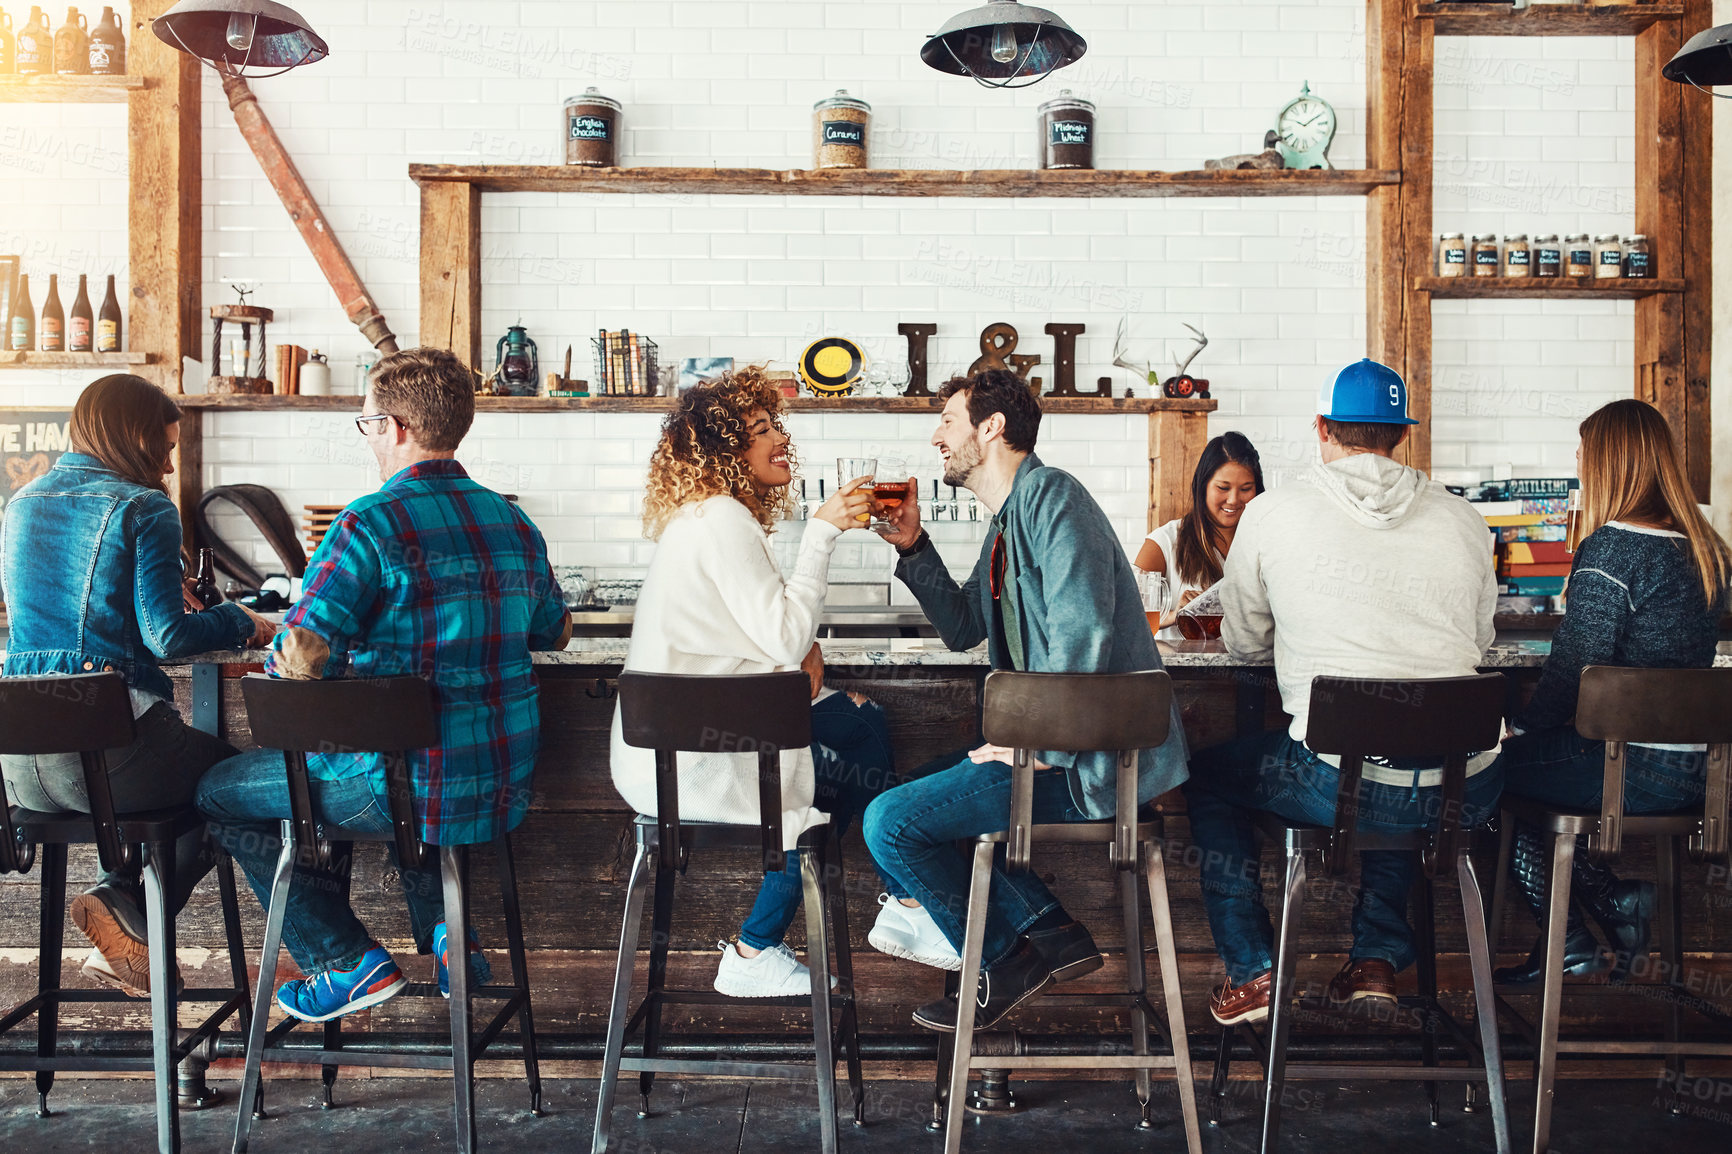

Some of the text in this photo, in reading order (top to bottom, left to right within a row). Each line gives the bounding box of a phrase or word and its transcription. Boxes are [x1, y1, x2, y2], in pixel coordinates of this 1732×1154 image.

[576, 118, 605, 130] English
[1054, 123, 1088, 135] Midnight
[572, 127, 607, 138] Chocolate
[826, 126, 860, 140] Caramel
[1060, 132, 1086, 142] Wheat
[1044, 322, 1112, 398] L
[1389, 384, 1400, 407] 9
